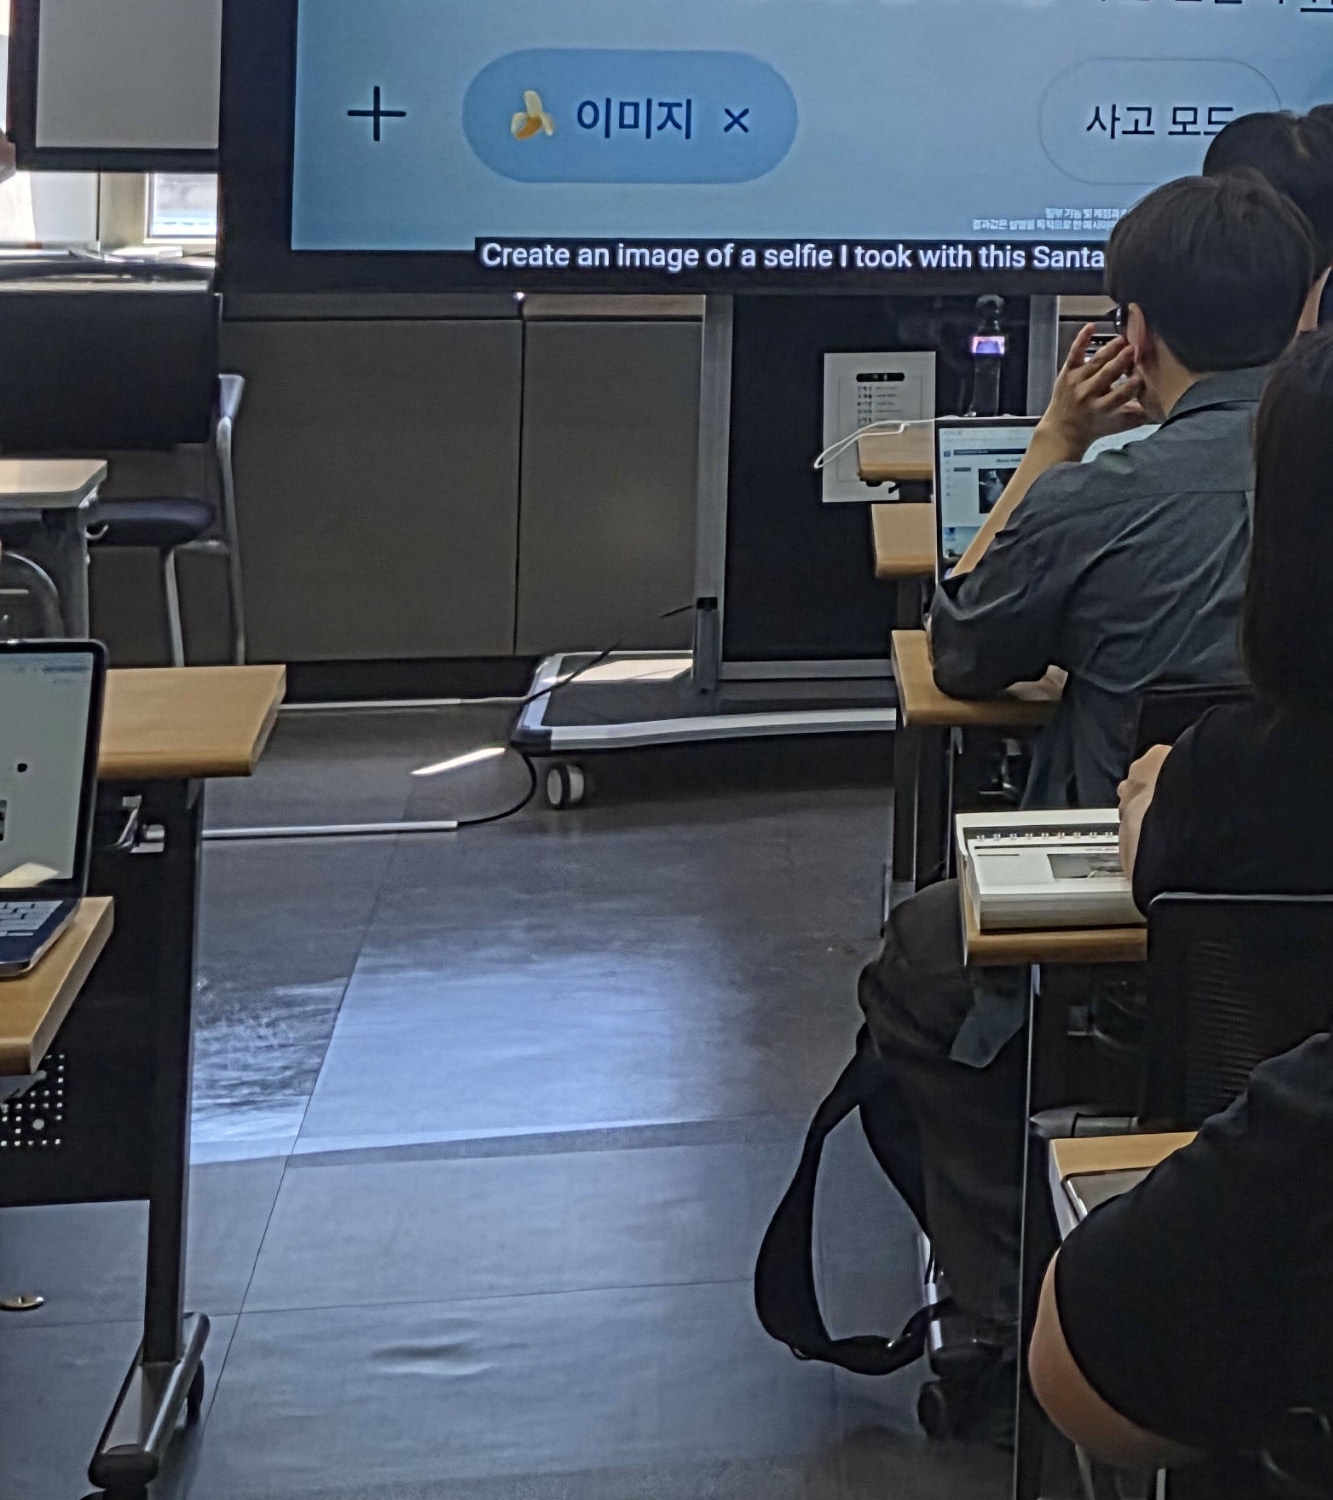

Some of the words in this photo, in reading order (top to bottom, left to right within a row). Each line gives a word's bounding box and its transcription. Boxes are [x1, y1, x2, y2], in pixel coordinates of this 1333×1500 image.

[576, 97, 692, 140] 이미지
[1086, 103, 1155, 140] 사고
[1167, 106, 1234, 136] 모드
[482, 243, 570, 267] Create
[577, 249, 610, 268] an
[617, 243, 699, 272] image
[706, 243, 735, 268] of
[740, 251, 756, 269] a
[763, 243, 836, 269] selfie
[840, 245, 848, 269] I
[854, 243, 912, 269] took
[918, 244, 972, 270] with
[977, 243, 1026, 269] this
[1032, 245, 1106, 269] Santa
